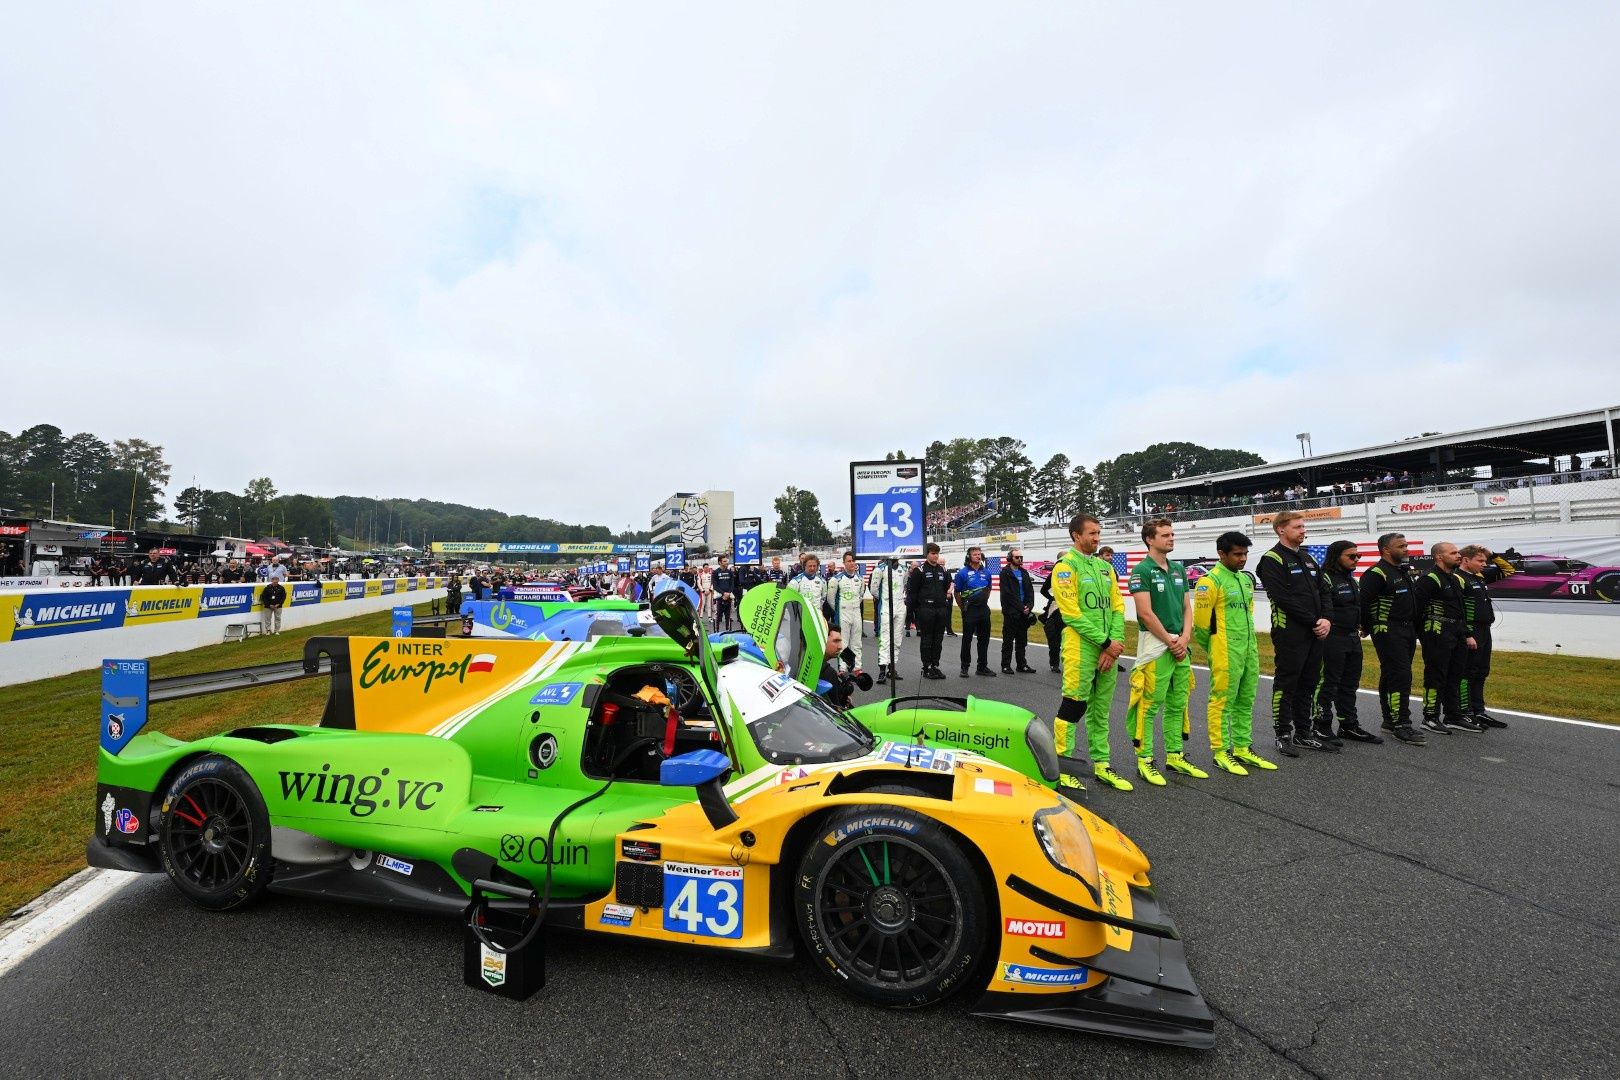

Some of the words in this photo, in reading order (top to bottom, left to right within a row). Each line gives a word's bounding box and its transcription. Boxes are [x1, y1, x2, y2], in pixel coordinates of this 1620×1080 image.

[1400, 502, 1436, 513] Ryder
[863, 502, 914, 538] 43
[4, 526, 19, 534] 911
[738, 538, 756, 556] 52
[638, 560, 648, 568] 04
[668, 554, 682, 564] 22
[296, 590, 318, 598] MICHELIN
[1571, 584, 1586, 594] 01
[140, 598, 192, 612] MICHELIN
[208, 594, 248, 606] MICHELIN
[36, 602, 116, 622] MICHELIN
[750, 604, 763, 630] GARG
[757, 598, 772, 633] CLARKE
[765, 588, 782, 636] DILLMANN
[397, 643, 443, 656] INTER
[118, 662, 144, 670] TENEG
[360, 640, 473, 694] Europol
[540, 688, 557, 696] AVL
[936, 728, 970, 744] plain
[973, 732, 1010, 750] sight
[171, 761, 218, 793] MICHELIN
[278, 763, 444, 818] wing.vc
[846, 816, 914, 835] MICHELIN
[528, 836, 588, 865] Quin
[386, 858, 412, 874] LMP2
[666, 864, 740, 877] WeatherTech
[802, 874, 813, 890] FR
[669, 879, 740, 936] 43
[1008, 921, 1064, 936] MOTUL
[1024, 972, 1083, 982] MICHELIN
